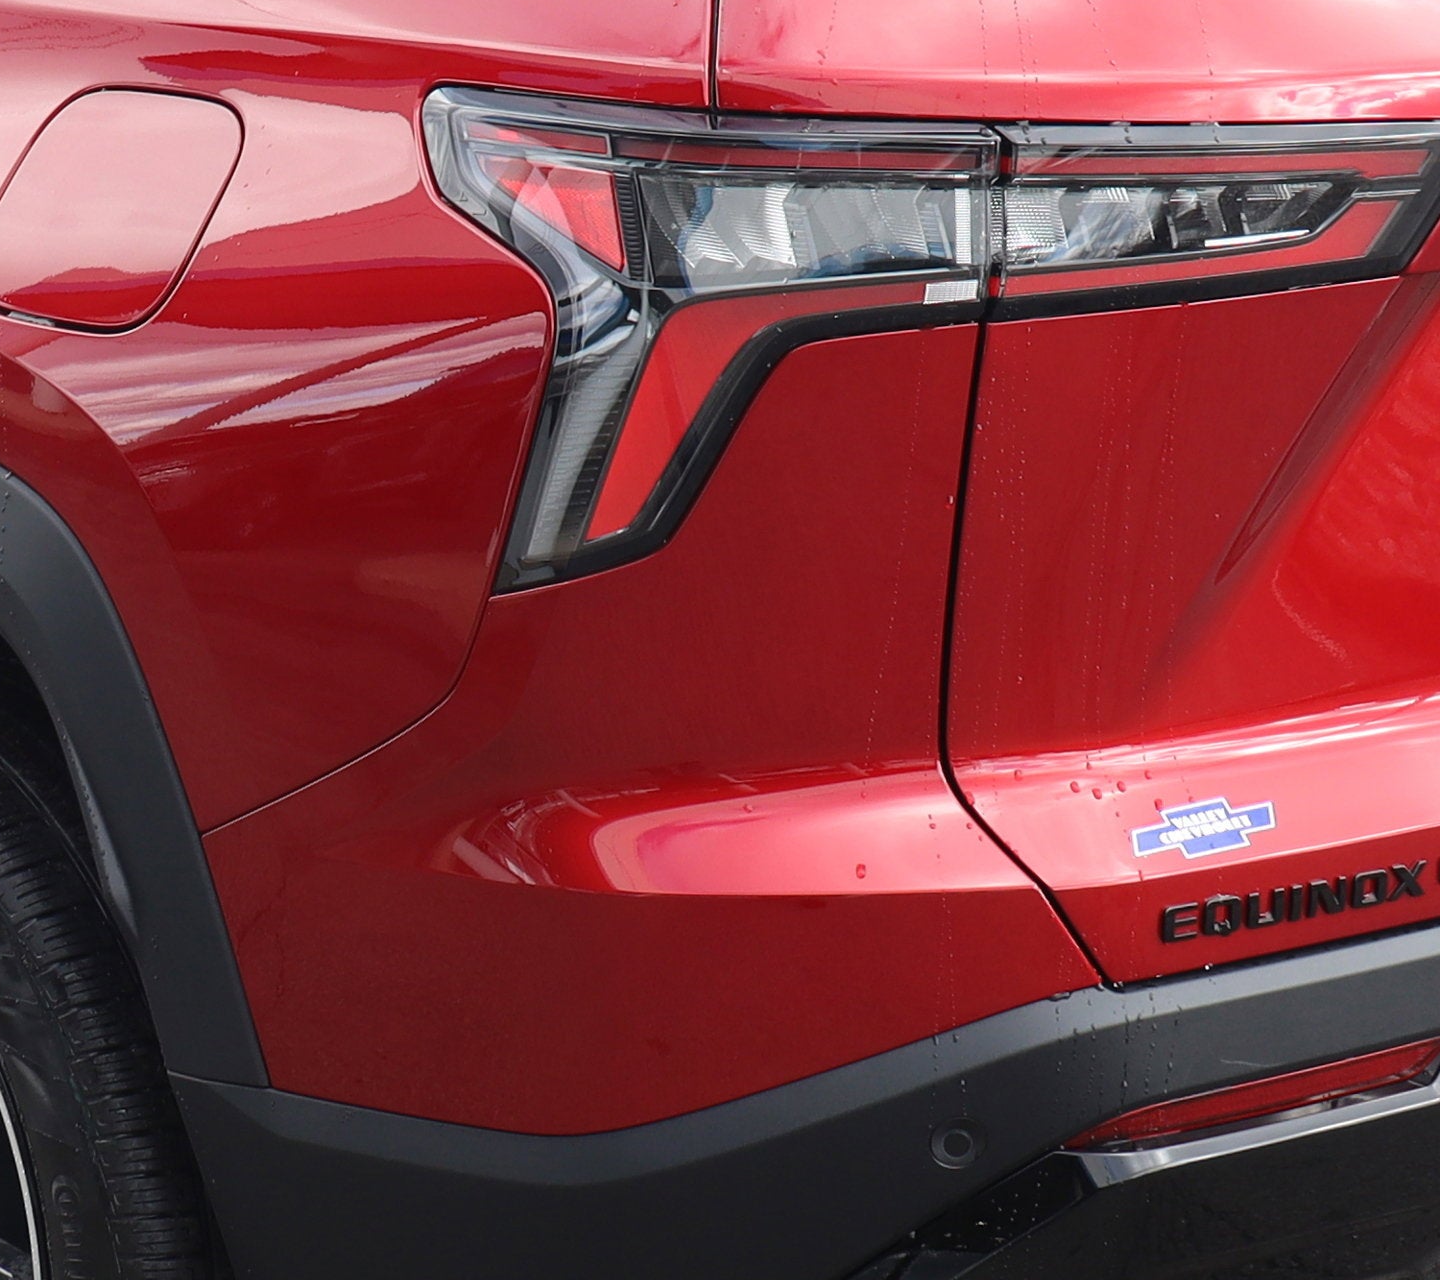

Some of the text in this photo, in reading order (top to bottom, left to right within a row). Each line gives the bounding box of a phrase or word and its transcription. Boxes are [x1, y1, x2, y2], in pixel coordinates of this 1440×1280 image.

[1158, 814, 1252, 845] CHEVROLET
[1170, 808, 1228, 829] VALLEY
[1160, 859, 1427, 944] EQUINOX
